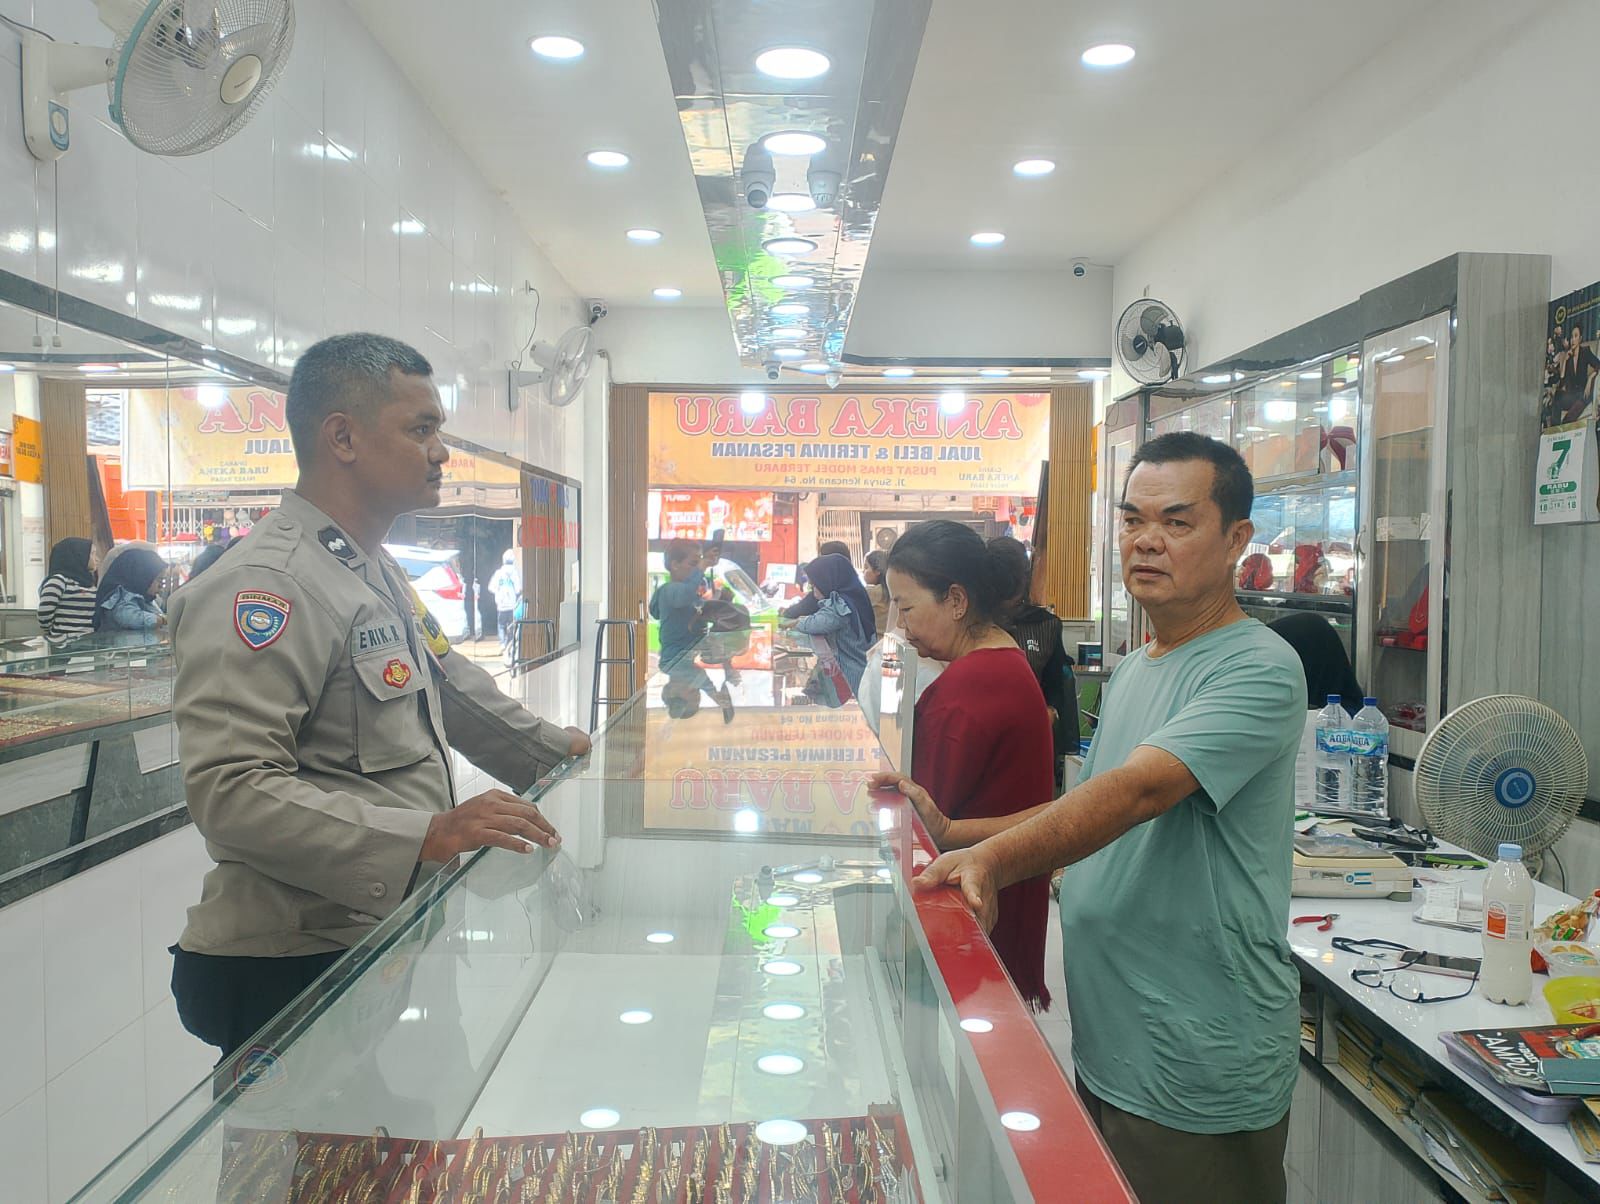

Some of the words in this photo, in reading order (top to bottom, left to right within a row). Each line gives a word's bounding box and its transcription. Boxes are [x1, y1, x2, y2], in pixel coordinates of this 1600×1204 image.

[1552, 439, 1572, 479] 7
[1329, 734, 1351, 744] AQUA
[670, 767, 816, 815] BARU
